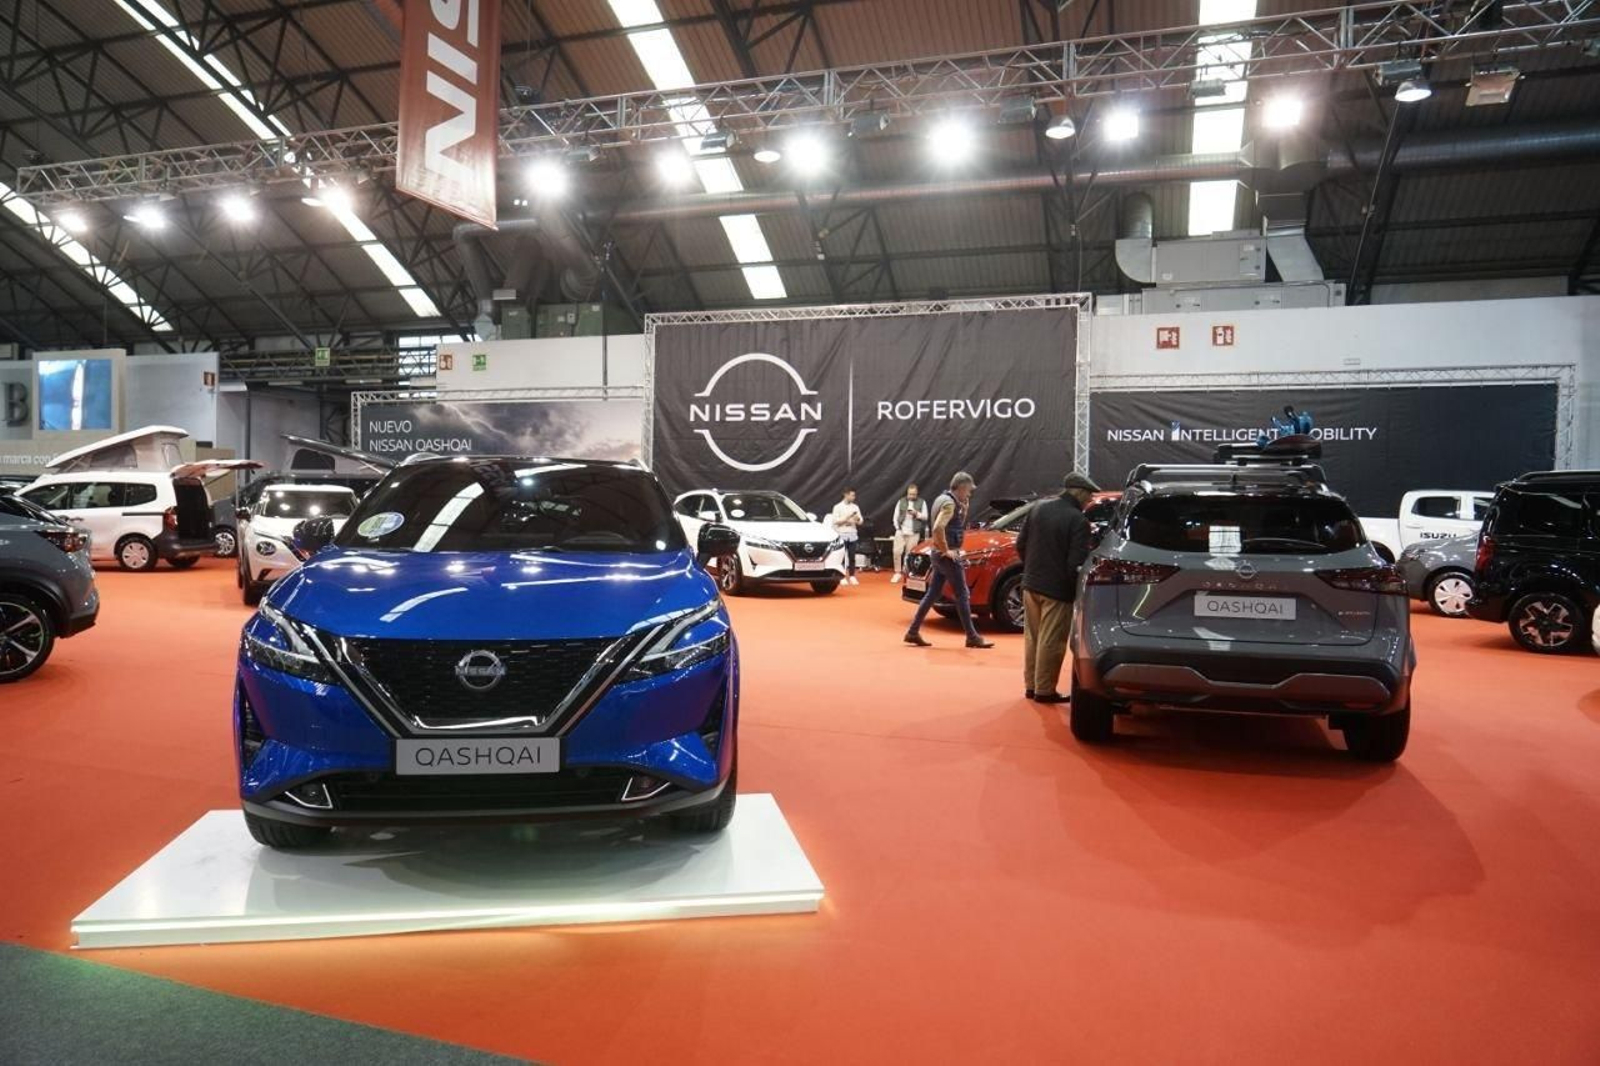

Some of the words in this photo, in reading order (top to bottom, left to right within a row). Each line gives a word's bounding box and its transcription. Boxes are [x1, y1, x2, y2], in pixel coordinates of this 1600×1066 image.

[6, 382, 29, 427] B
[689, 402, 822, 422] NISSAN
[877, 398, 1035, 420] ROFERVIGO
[369, 420, 412, 433] NUEVO
[1107, 429, 1164, 442] NISSAN
[1308, 427, 1377, 440] OBILITY
[369, 440, 412, 451] NISSAN
[415, 439, 472, 451] QASHQAI
[1207, 600, 1283, 615] QASHQAI
[415, 746, 541, 766] QASHQAI
